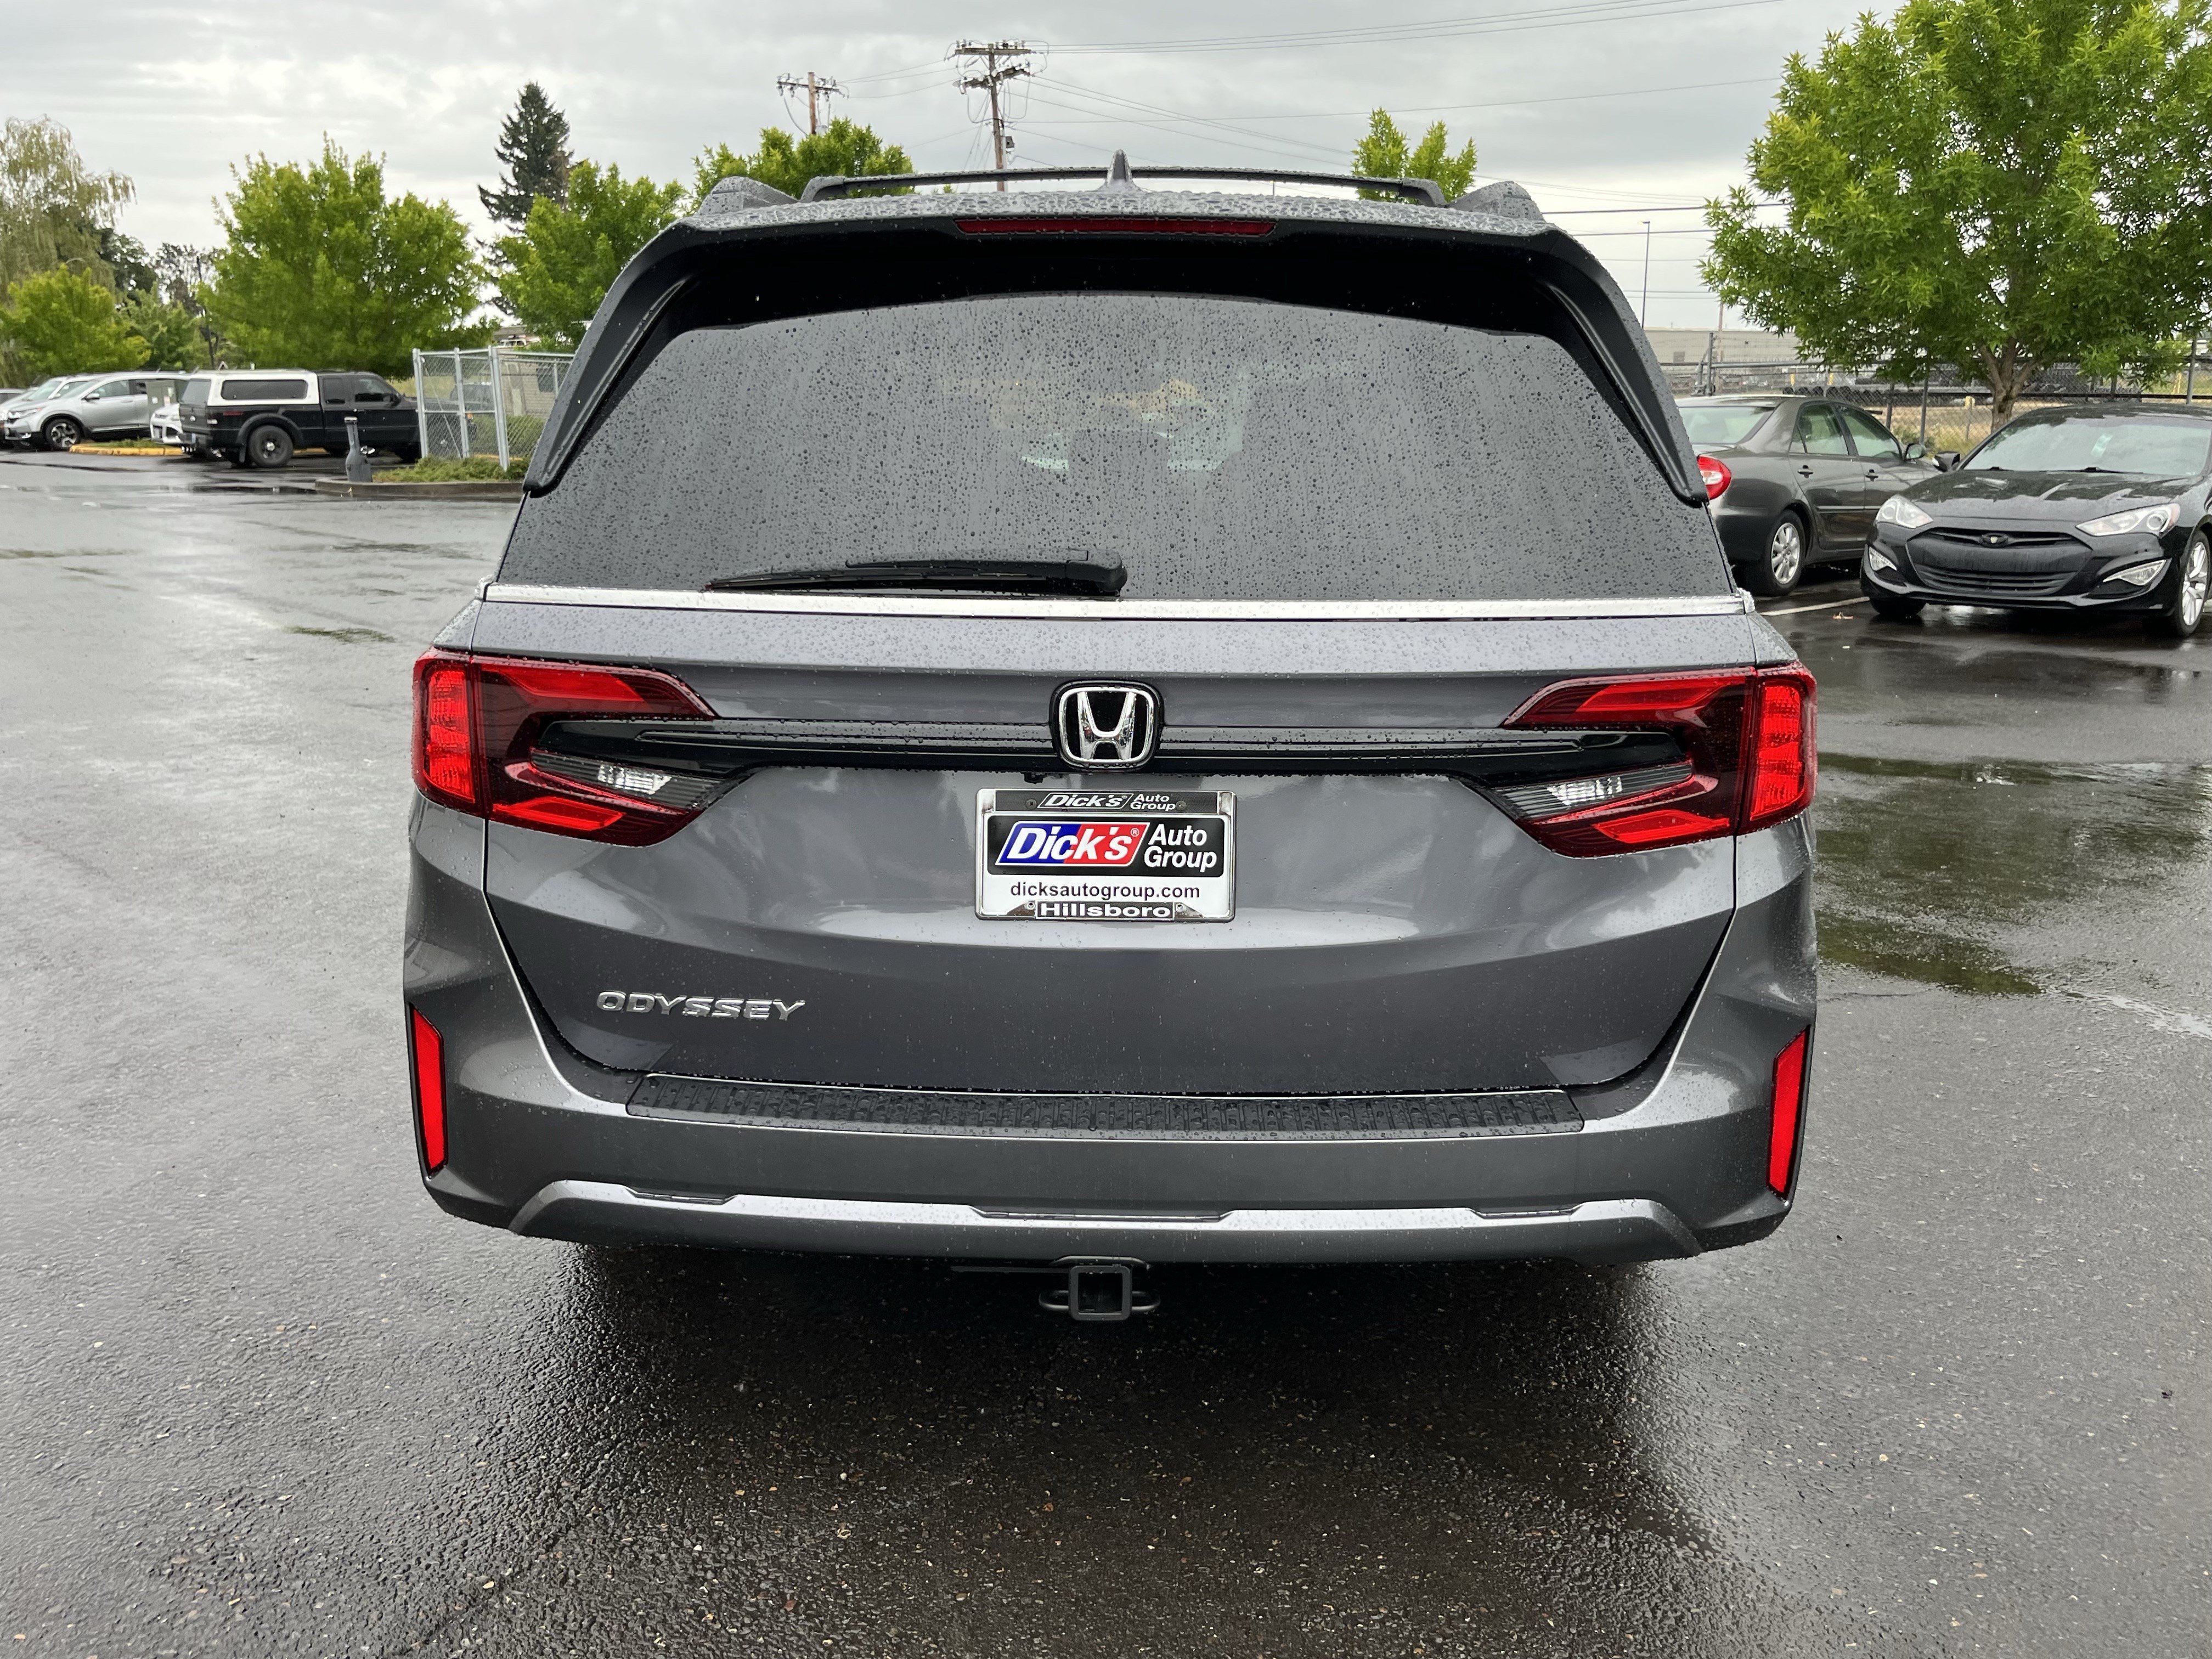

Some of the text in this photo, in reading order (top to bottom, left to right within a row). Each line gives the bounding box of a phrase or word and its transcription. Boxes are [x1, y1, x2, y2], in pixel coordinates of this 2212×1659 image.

[1044, 793, 1170, 807] Dick's Auto
[1130, 801, 1176, 811] Group
[1006, 823, 1207, 860] Dick's Auto
[1144, 846, 1217, 872] Group
[1011, 881, 1200, 901] dicksautogroup.com
[1040, 902, 1172, 918] Hillsboro
[596, 990, 806, 1021] ODYSSEY
